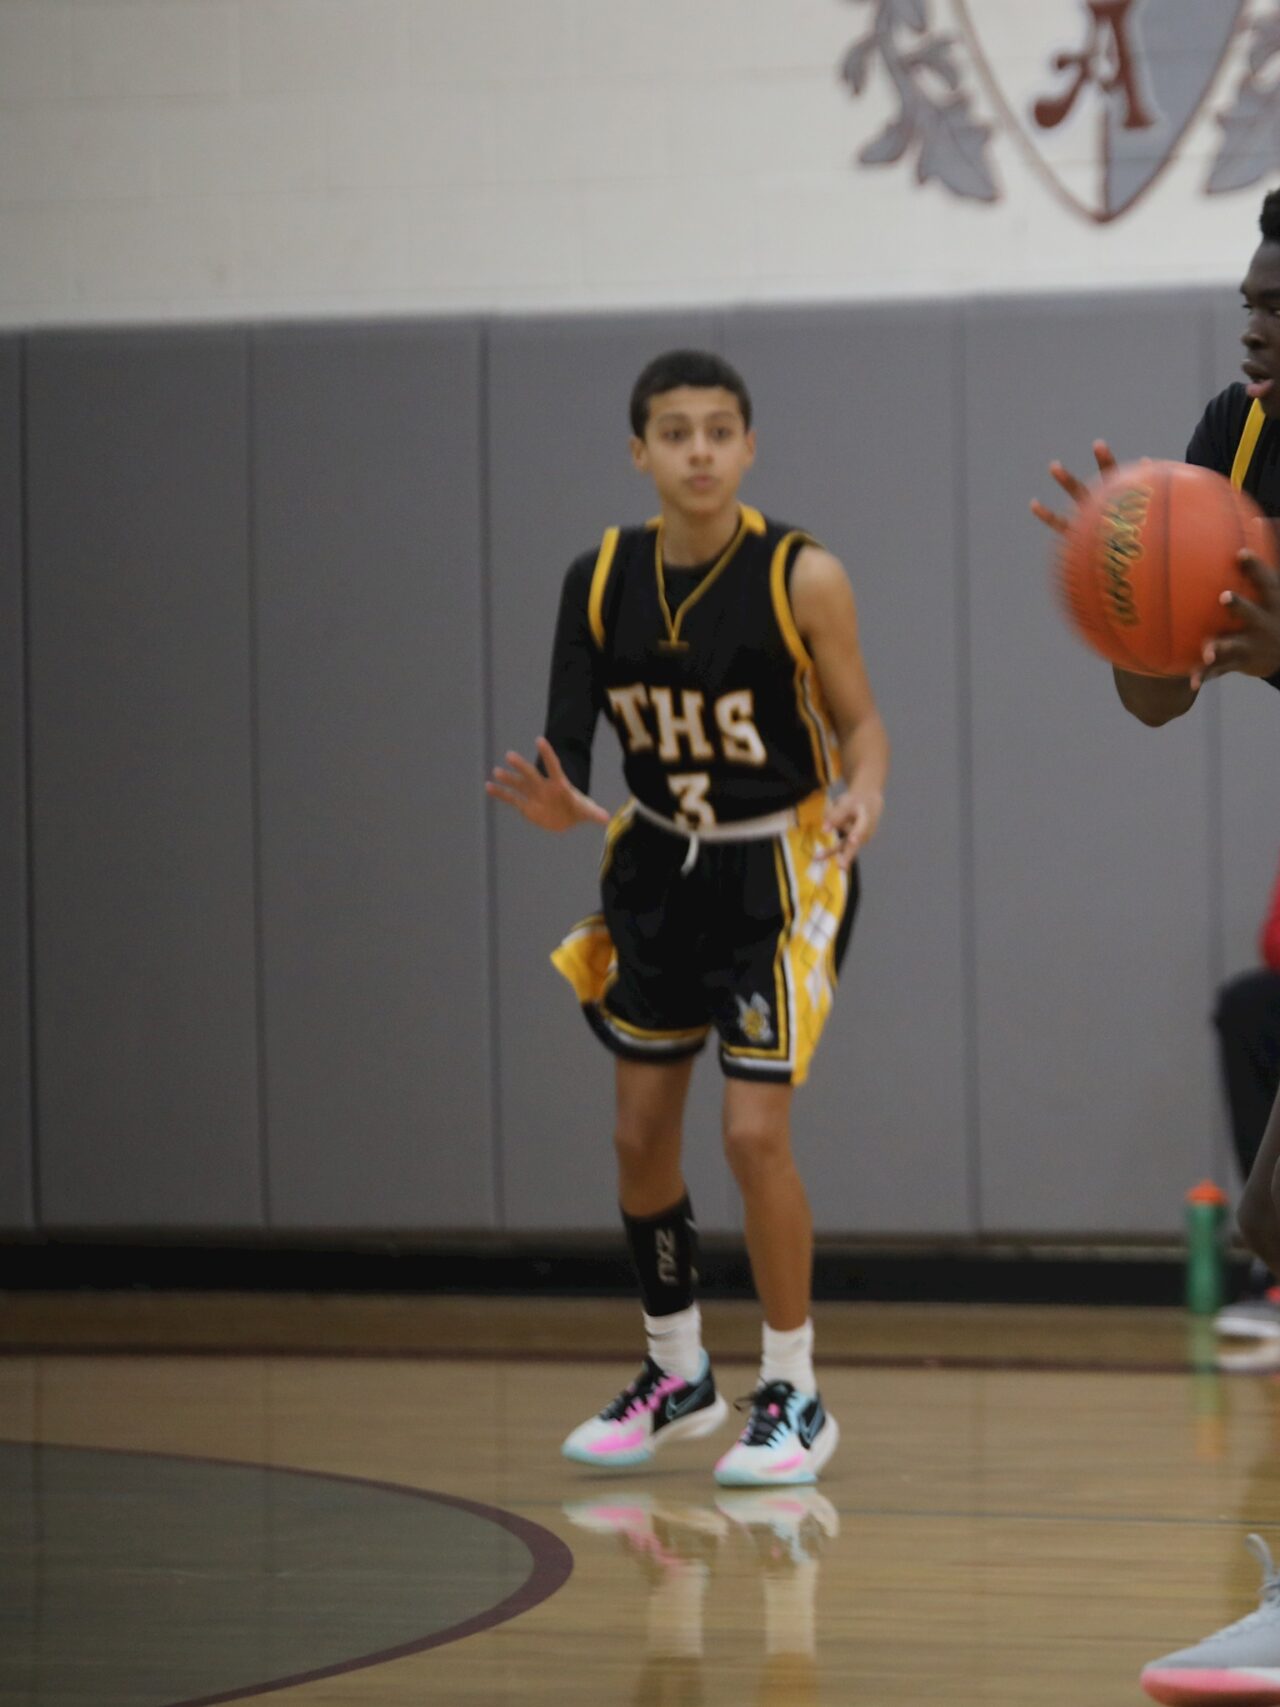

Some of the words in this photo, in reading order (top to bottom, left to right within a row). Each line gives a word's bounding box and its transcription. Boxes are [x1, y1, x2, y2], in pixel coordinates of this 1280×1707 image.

[1033, 0, 1154, 128] A
[606, 684, 767, 766] THS
[667, 772, 716, 833] 3
